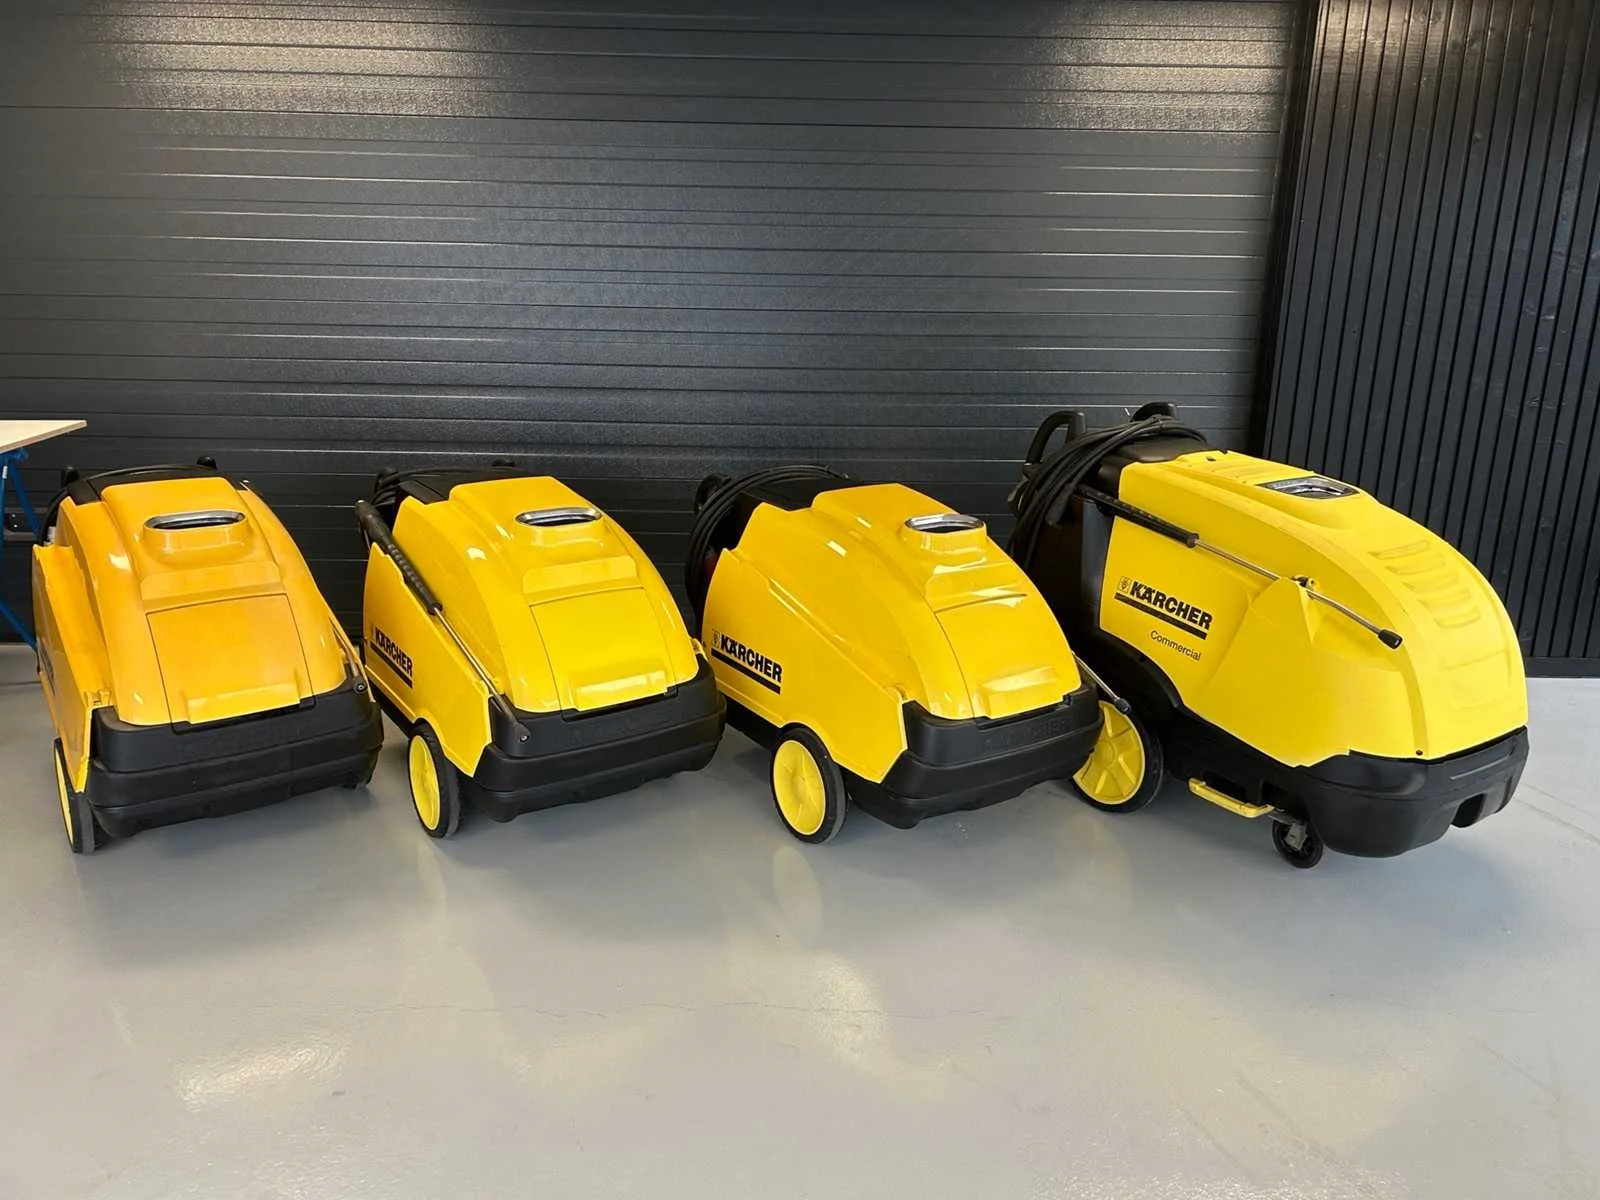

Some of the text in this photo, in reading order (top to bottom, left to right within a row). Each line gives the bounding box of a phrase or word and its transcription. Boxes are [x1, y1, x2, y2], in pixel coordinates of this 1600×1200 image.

[1130, 581, 1213, 630] KÄRCHER
[721, 633, 782, 683] KÄRCHER
[1150, 630, 1201, 661] Commercial
